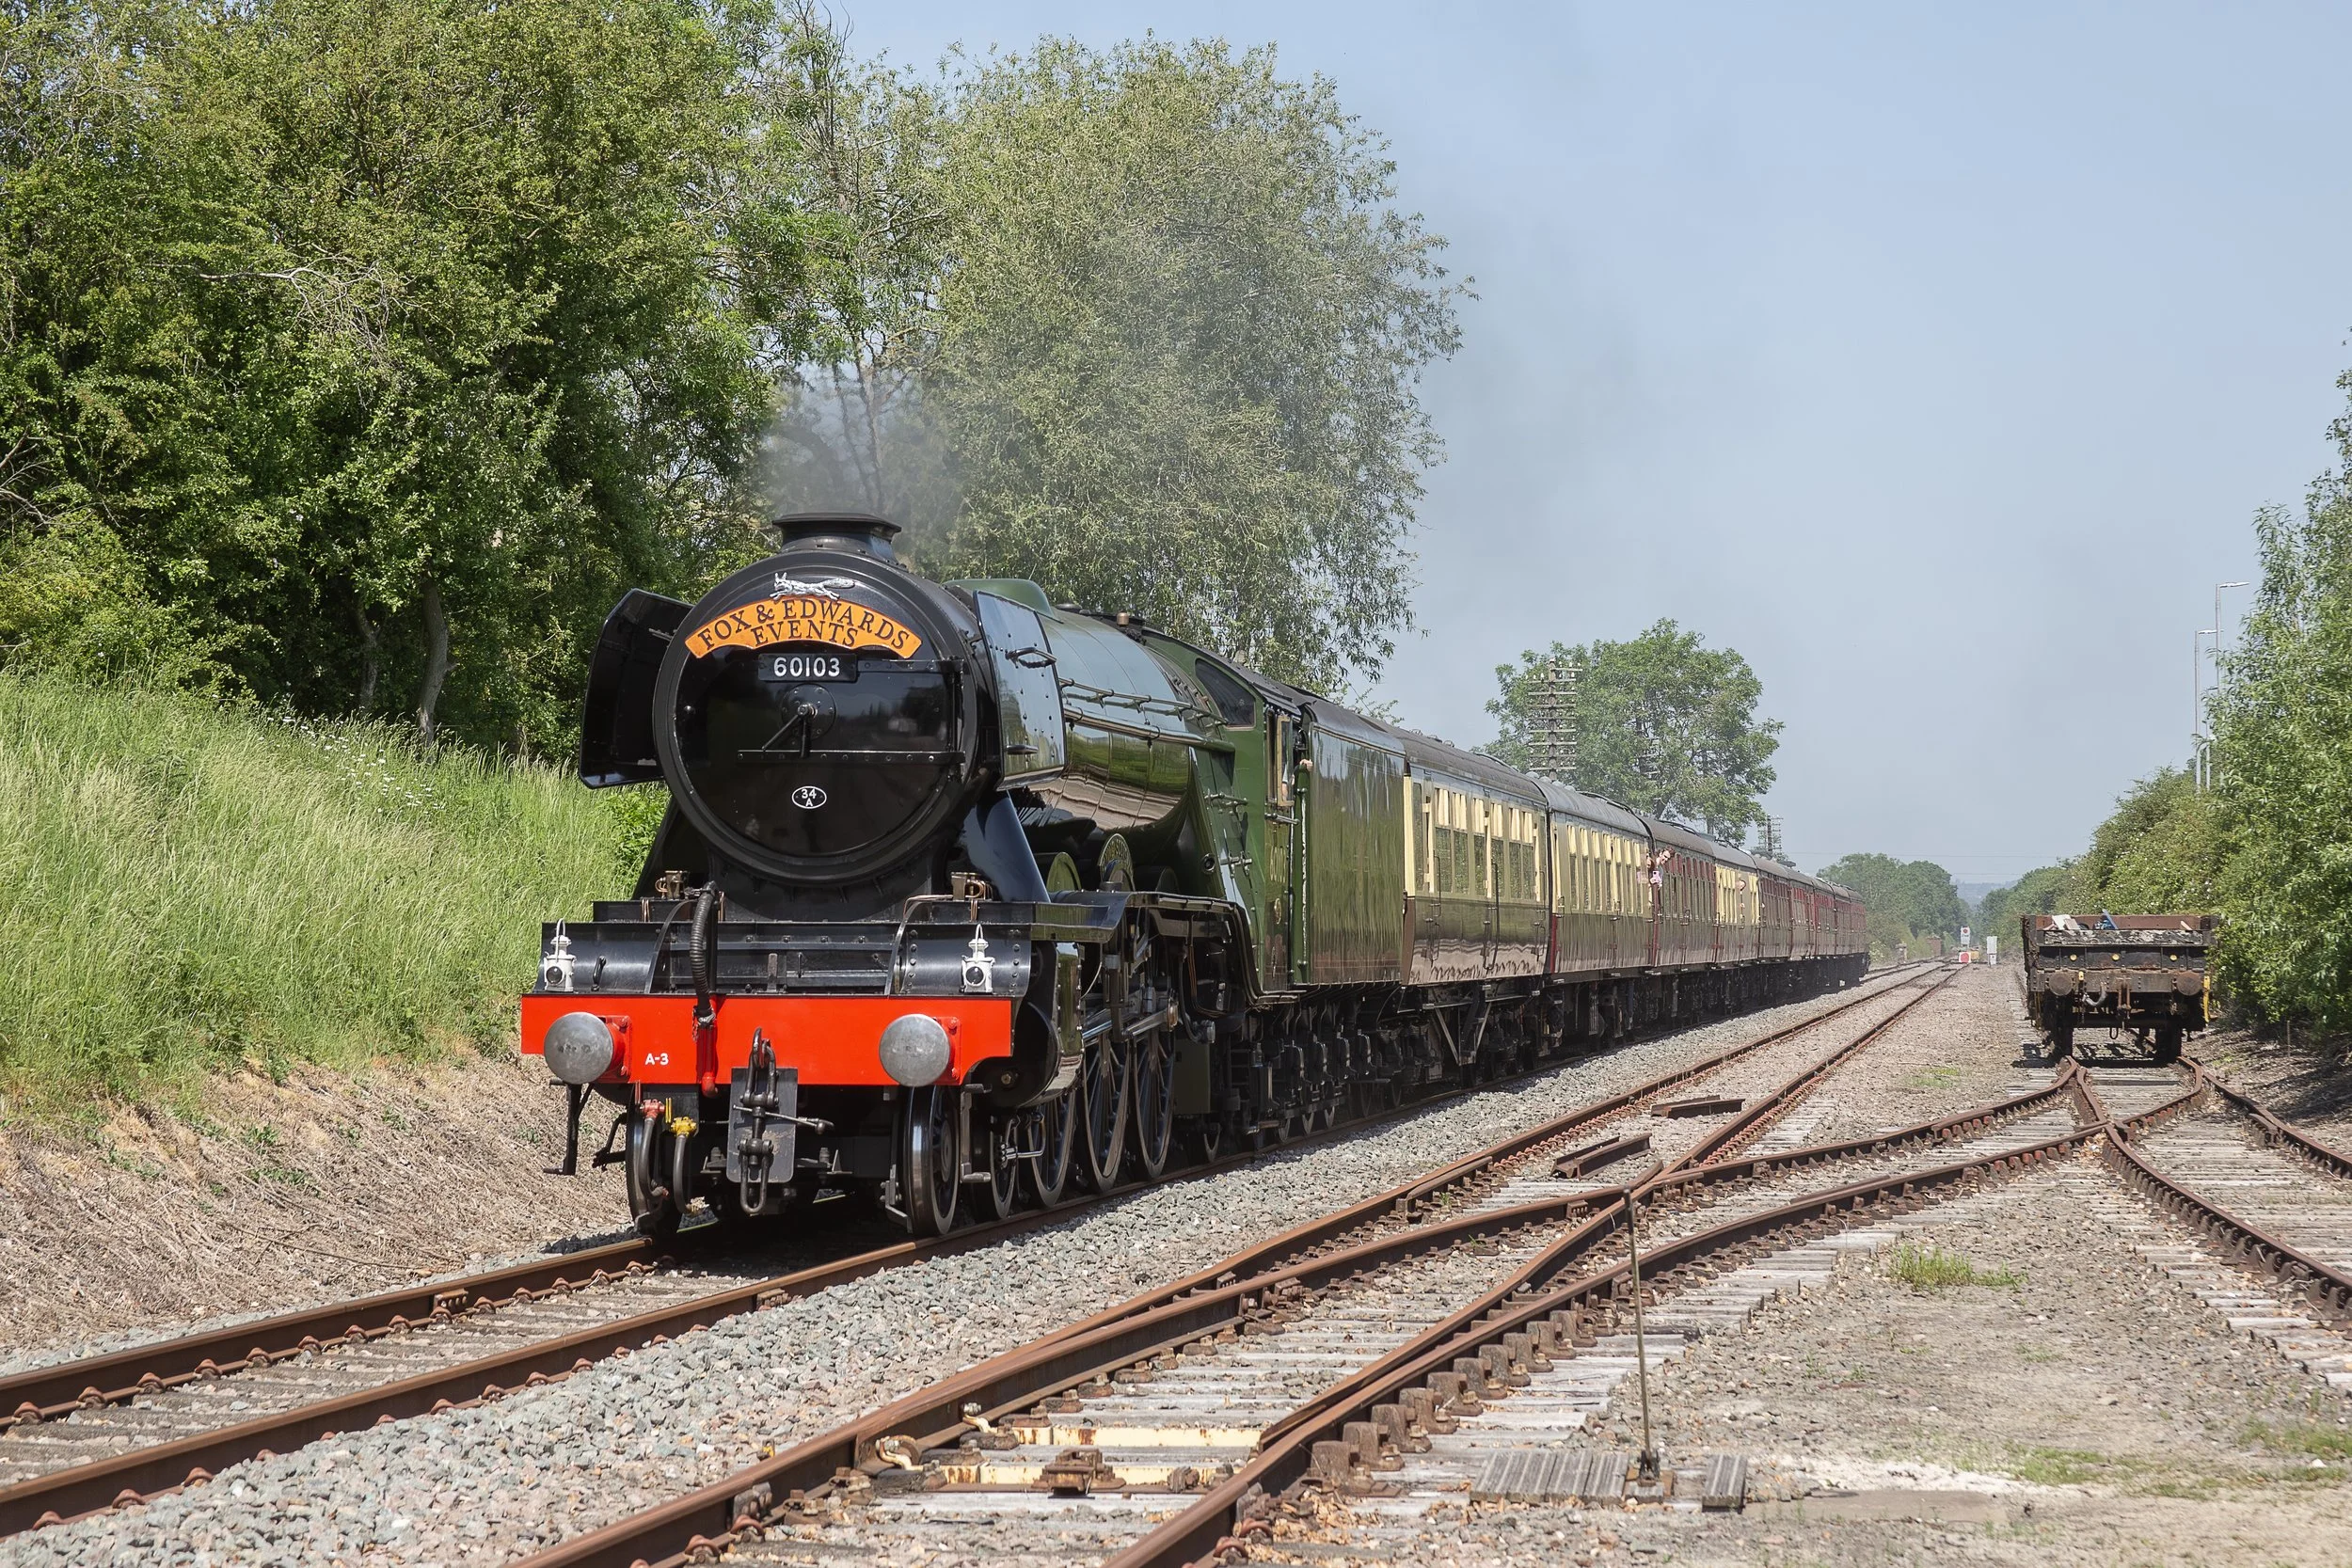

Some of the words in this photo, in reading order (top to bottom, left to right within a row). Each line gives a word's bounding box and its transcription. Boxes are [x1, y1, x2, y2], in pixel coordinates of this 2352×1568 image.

[698, 610, 751, 650] FOX
[756, 604, 775, 624] &
[783, 599, 910, 650] EDWARDS
[750, 619, 858, 646] EVENTS
[773, 657, 841, 677] 60103
[801, 788, 817, 800] 34
[805, 798, 813, 807] A
[644, 1053, 669, 1066] A-3
